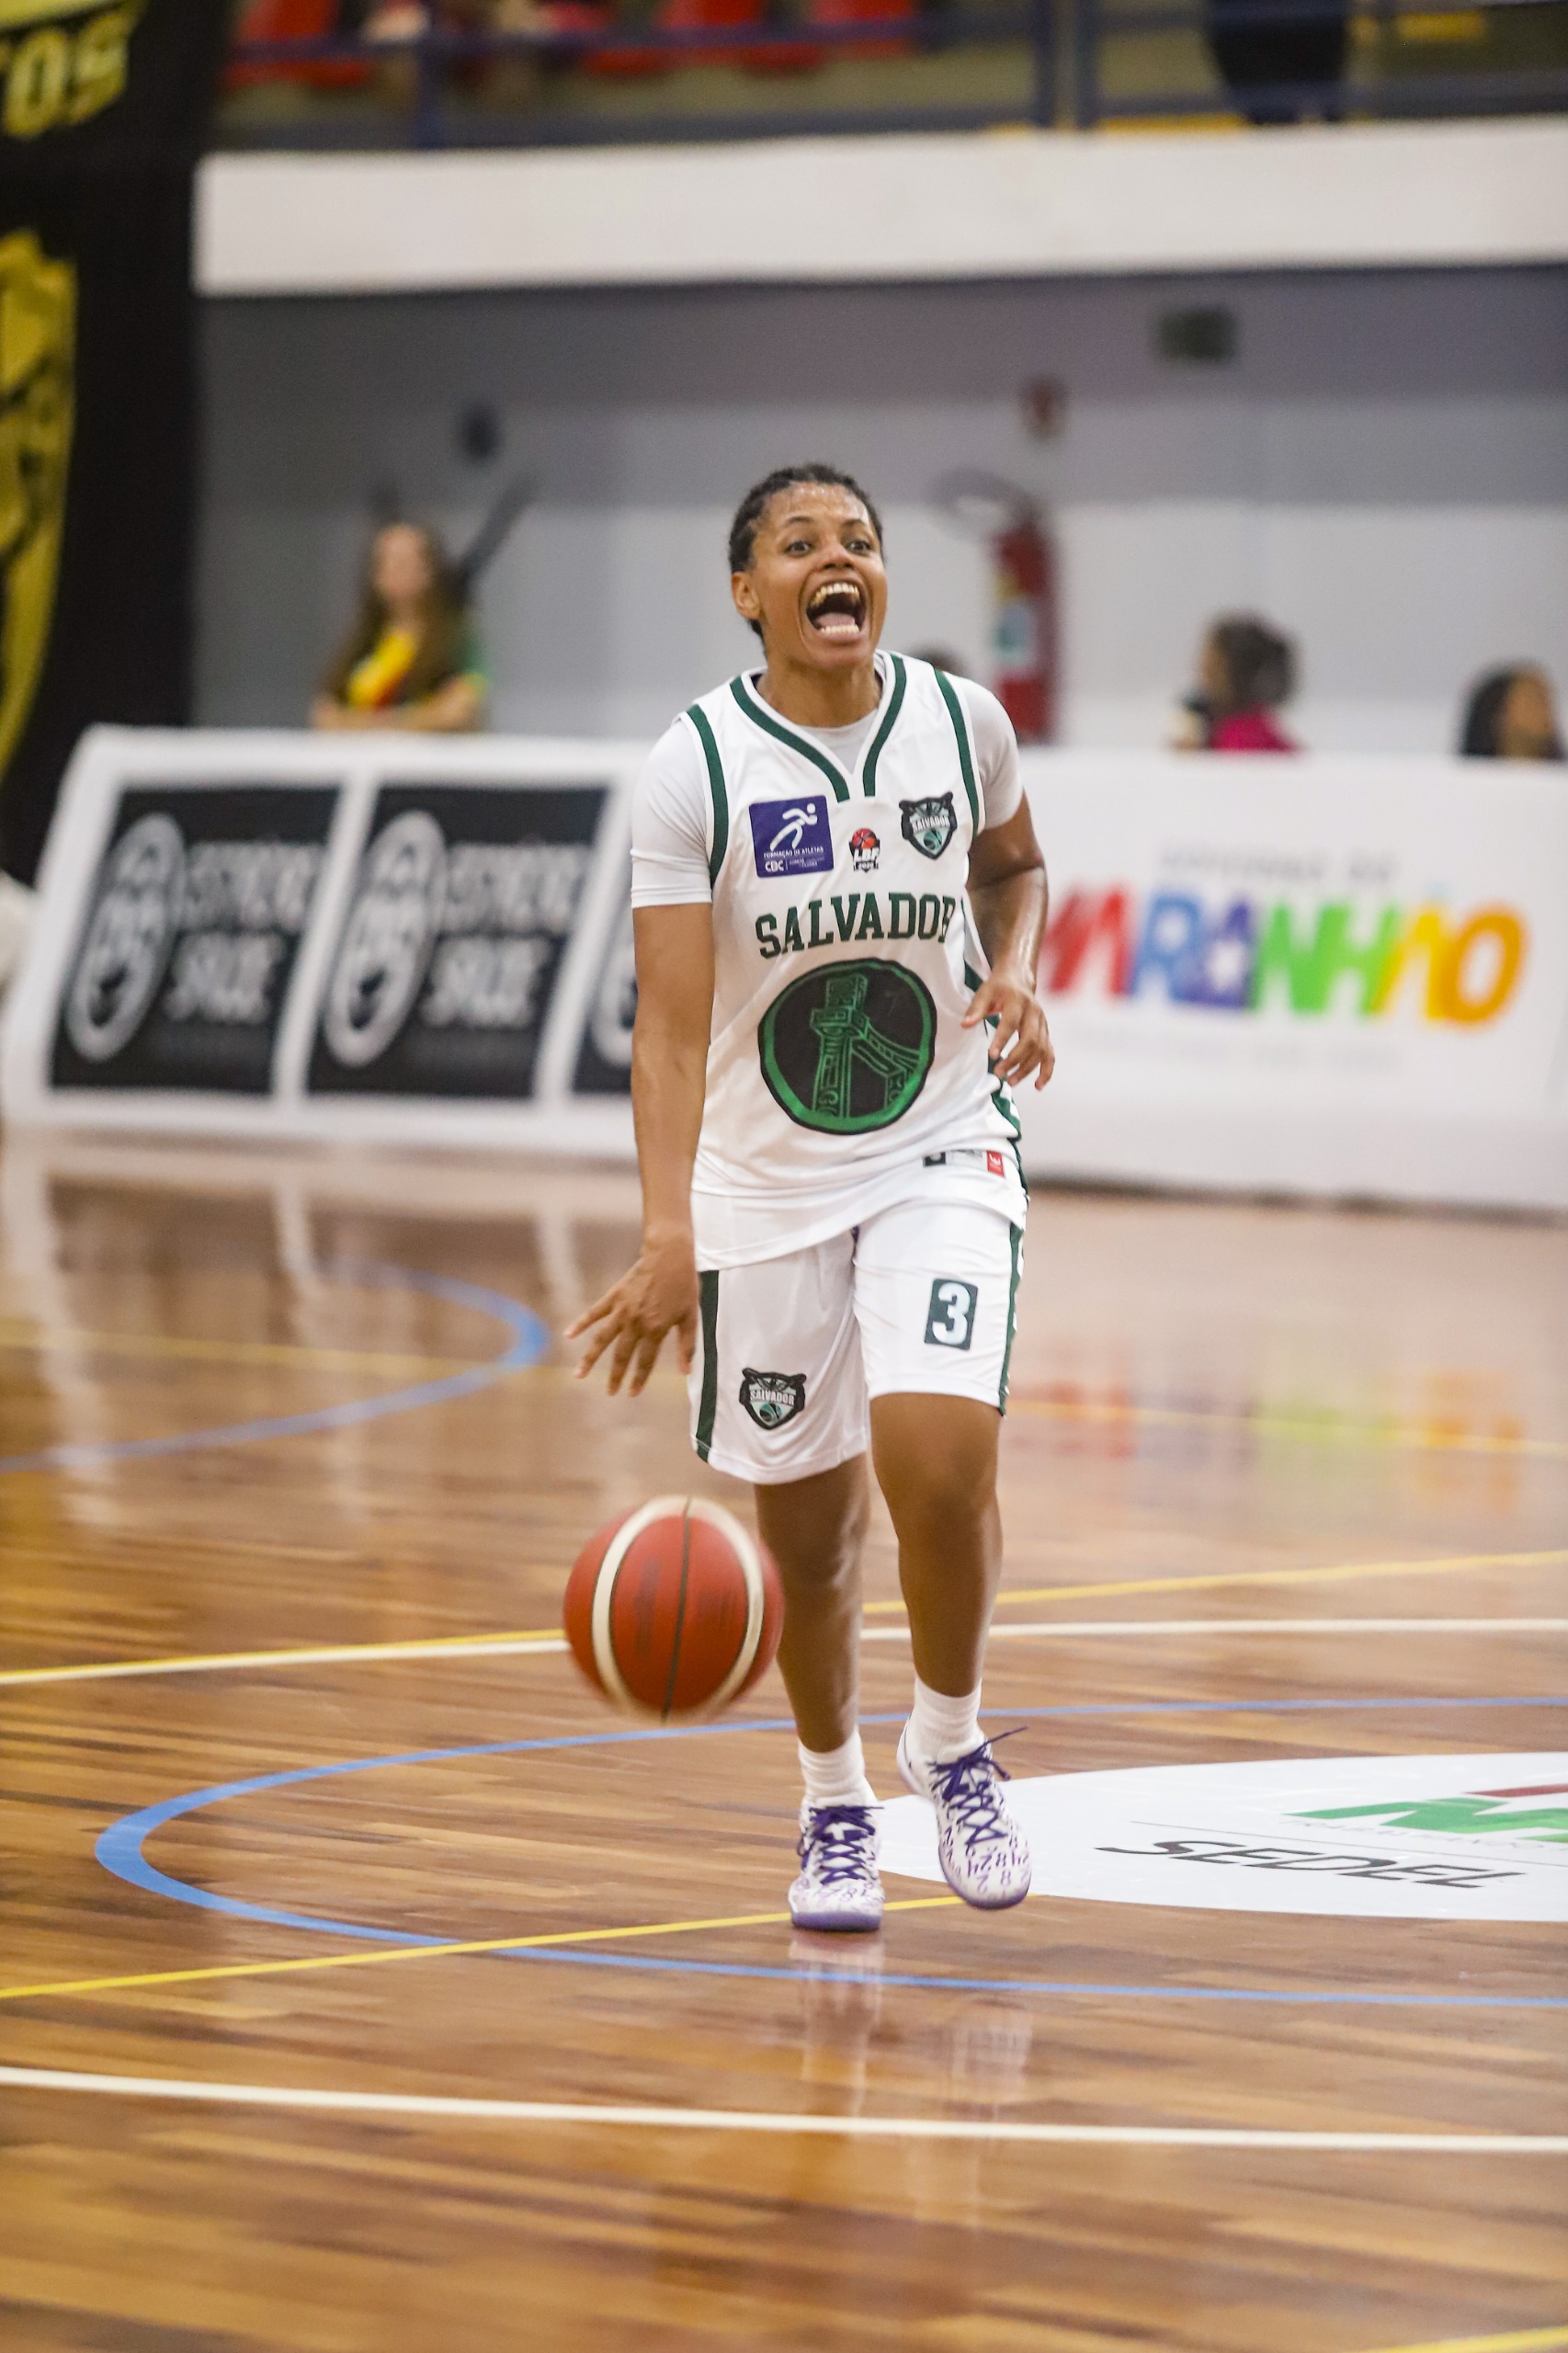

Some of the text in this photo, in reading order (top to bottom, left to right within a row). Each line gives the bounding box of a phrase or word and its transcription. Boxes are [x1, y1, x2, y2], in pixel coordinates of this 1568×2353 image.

[755, 892, 956, 959] SALVADOR
[932, 1281, 971, 1346] 3
[749, 1389, 795, 1406] SALVADOR
[1095, 1839, 1527, 1889] SEDEL
